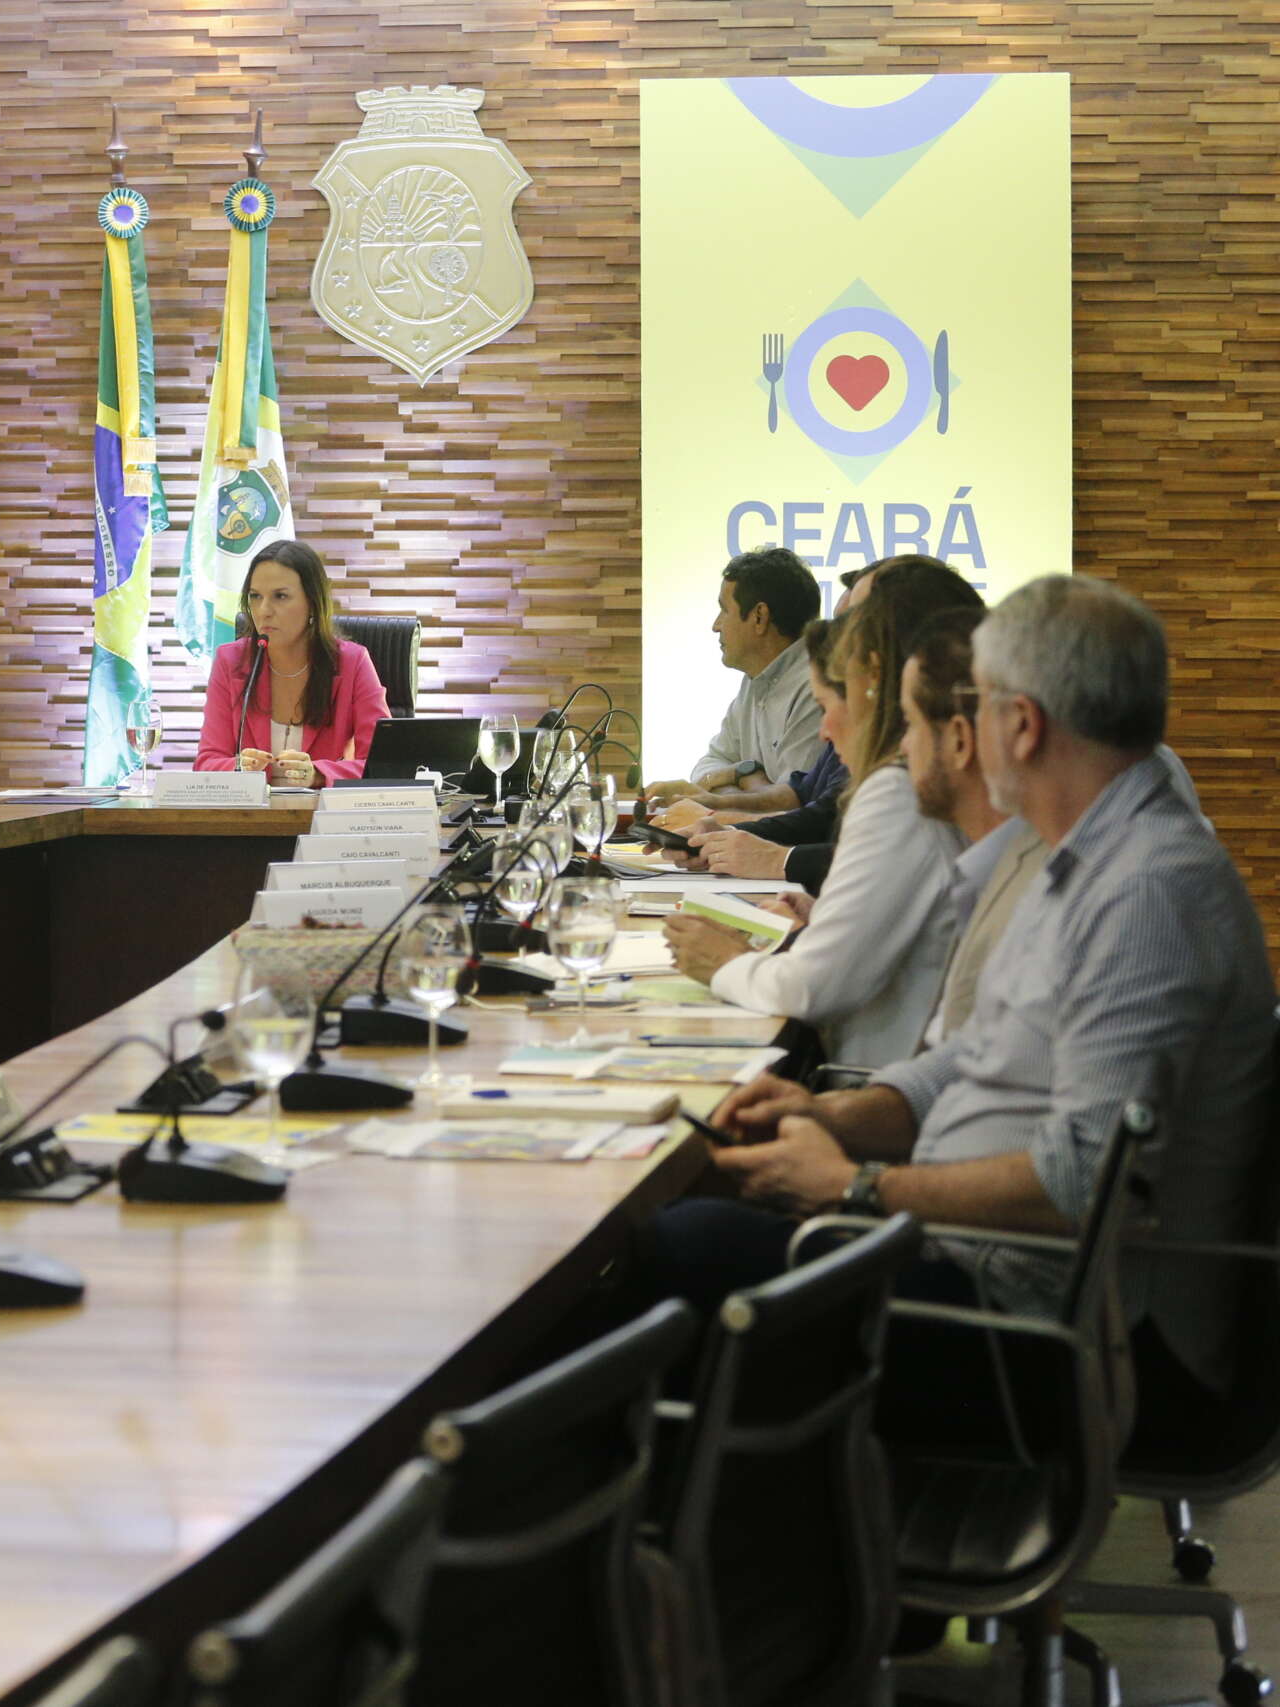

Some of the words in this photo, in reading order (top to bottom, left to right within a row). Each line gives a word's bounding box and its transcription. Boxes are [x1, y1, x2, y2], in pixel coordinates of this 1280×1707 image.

[726, 486, 987, 569] CEARÁ
[341, 851, 358, 859] CAIO
[358, 850, 400, 858] CAVALCANTI
[300, 881, 333, 890] MARCUS
[334, 879, 392, 889] ALBUQUERQUE
